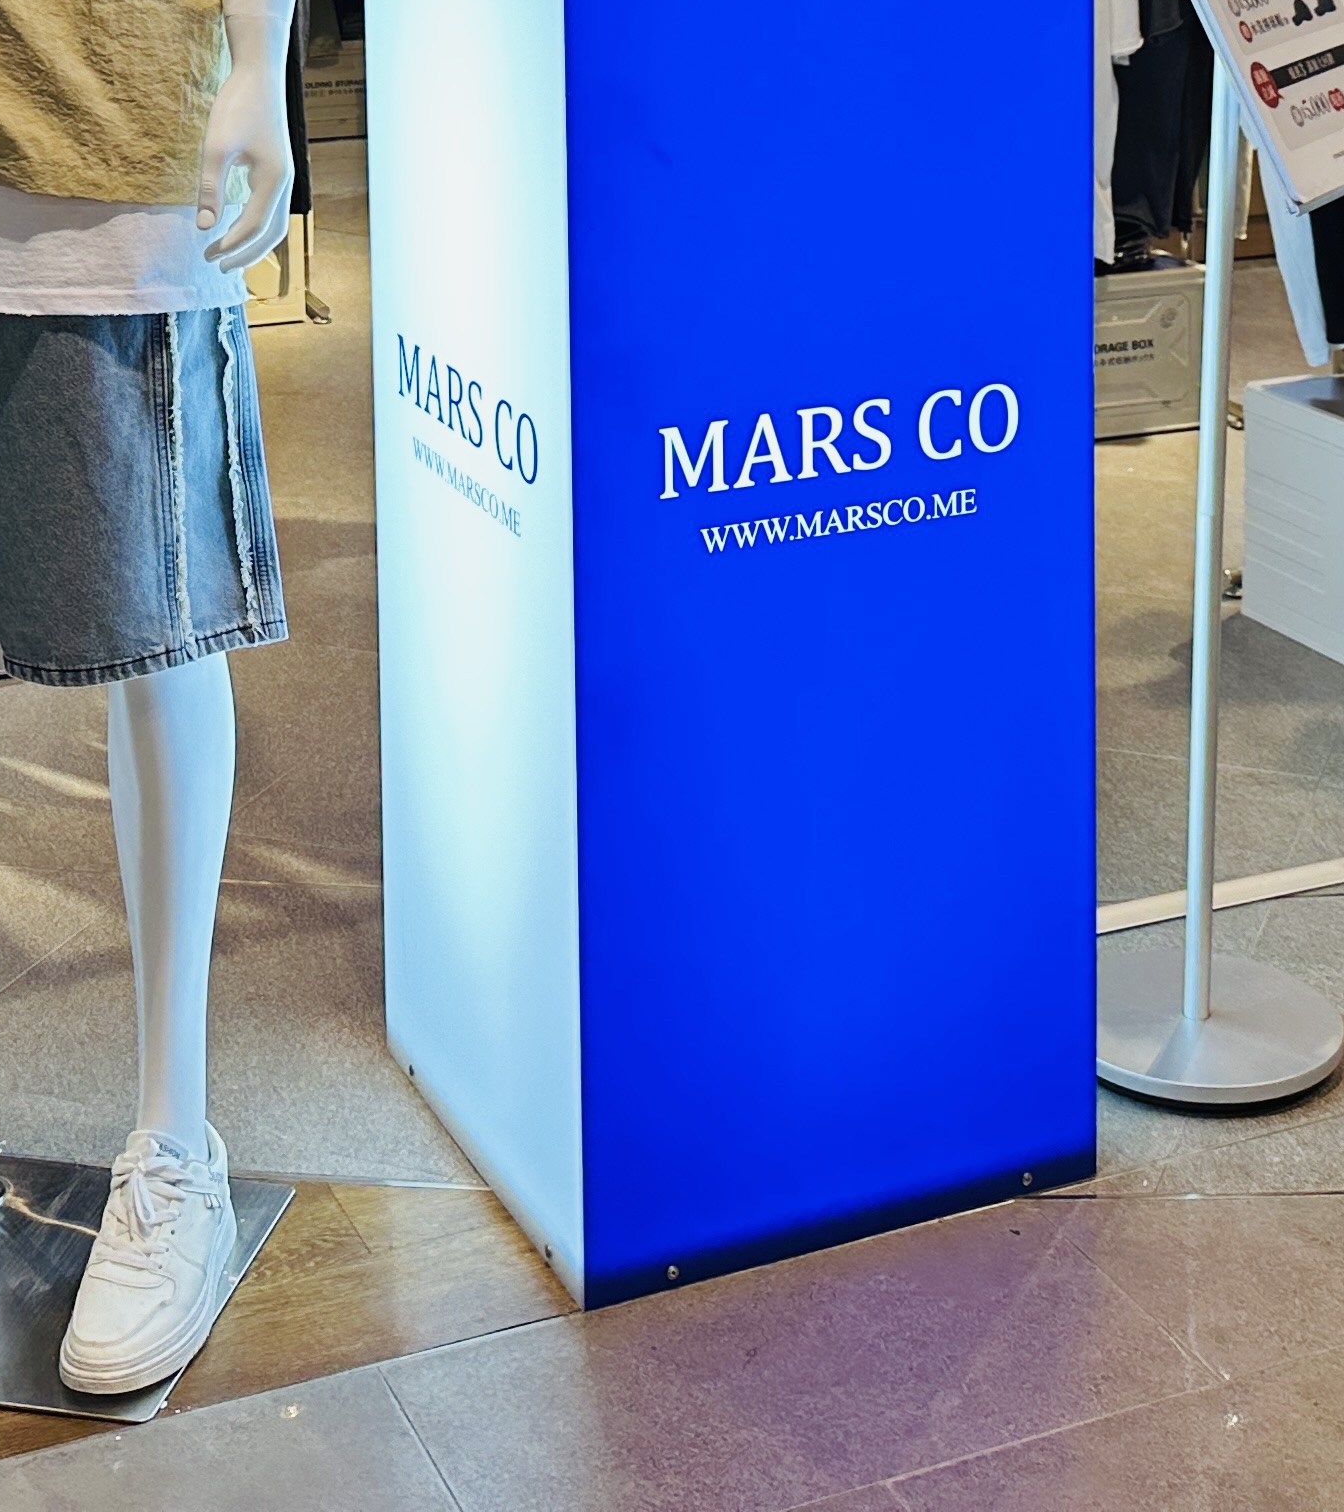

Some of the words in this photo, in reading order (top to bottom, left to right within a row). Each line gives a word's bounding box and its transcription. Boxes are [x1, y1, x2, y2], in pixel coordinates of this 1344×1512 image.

[1094, 341, 1129, 354] ORAGE
[1131, 339, 1154, 350] BOX
[397, 333, 483, 449] MARS
[494, 399, 538, 485] CO
[659, 398, 891, 499] MARS
[918, 383, 1020, 460] CO
[413, 436, 522, 538] WWW.MARSCO.ME
[700, 489, 978, 554] WWW.MARSCO.ME
